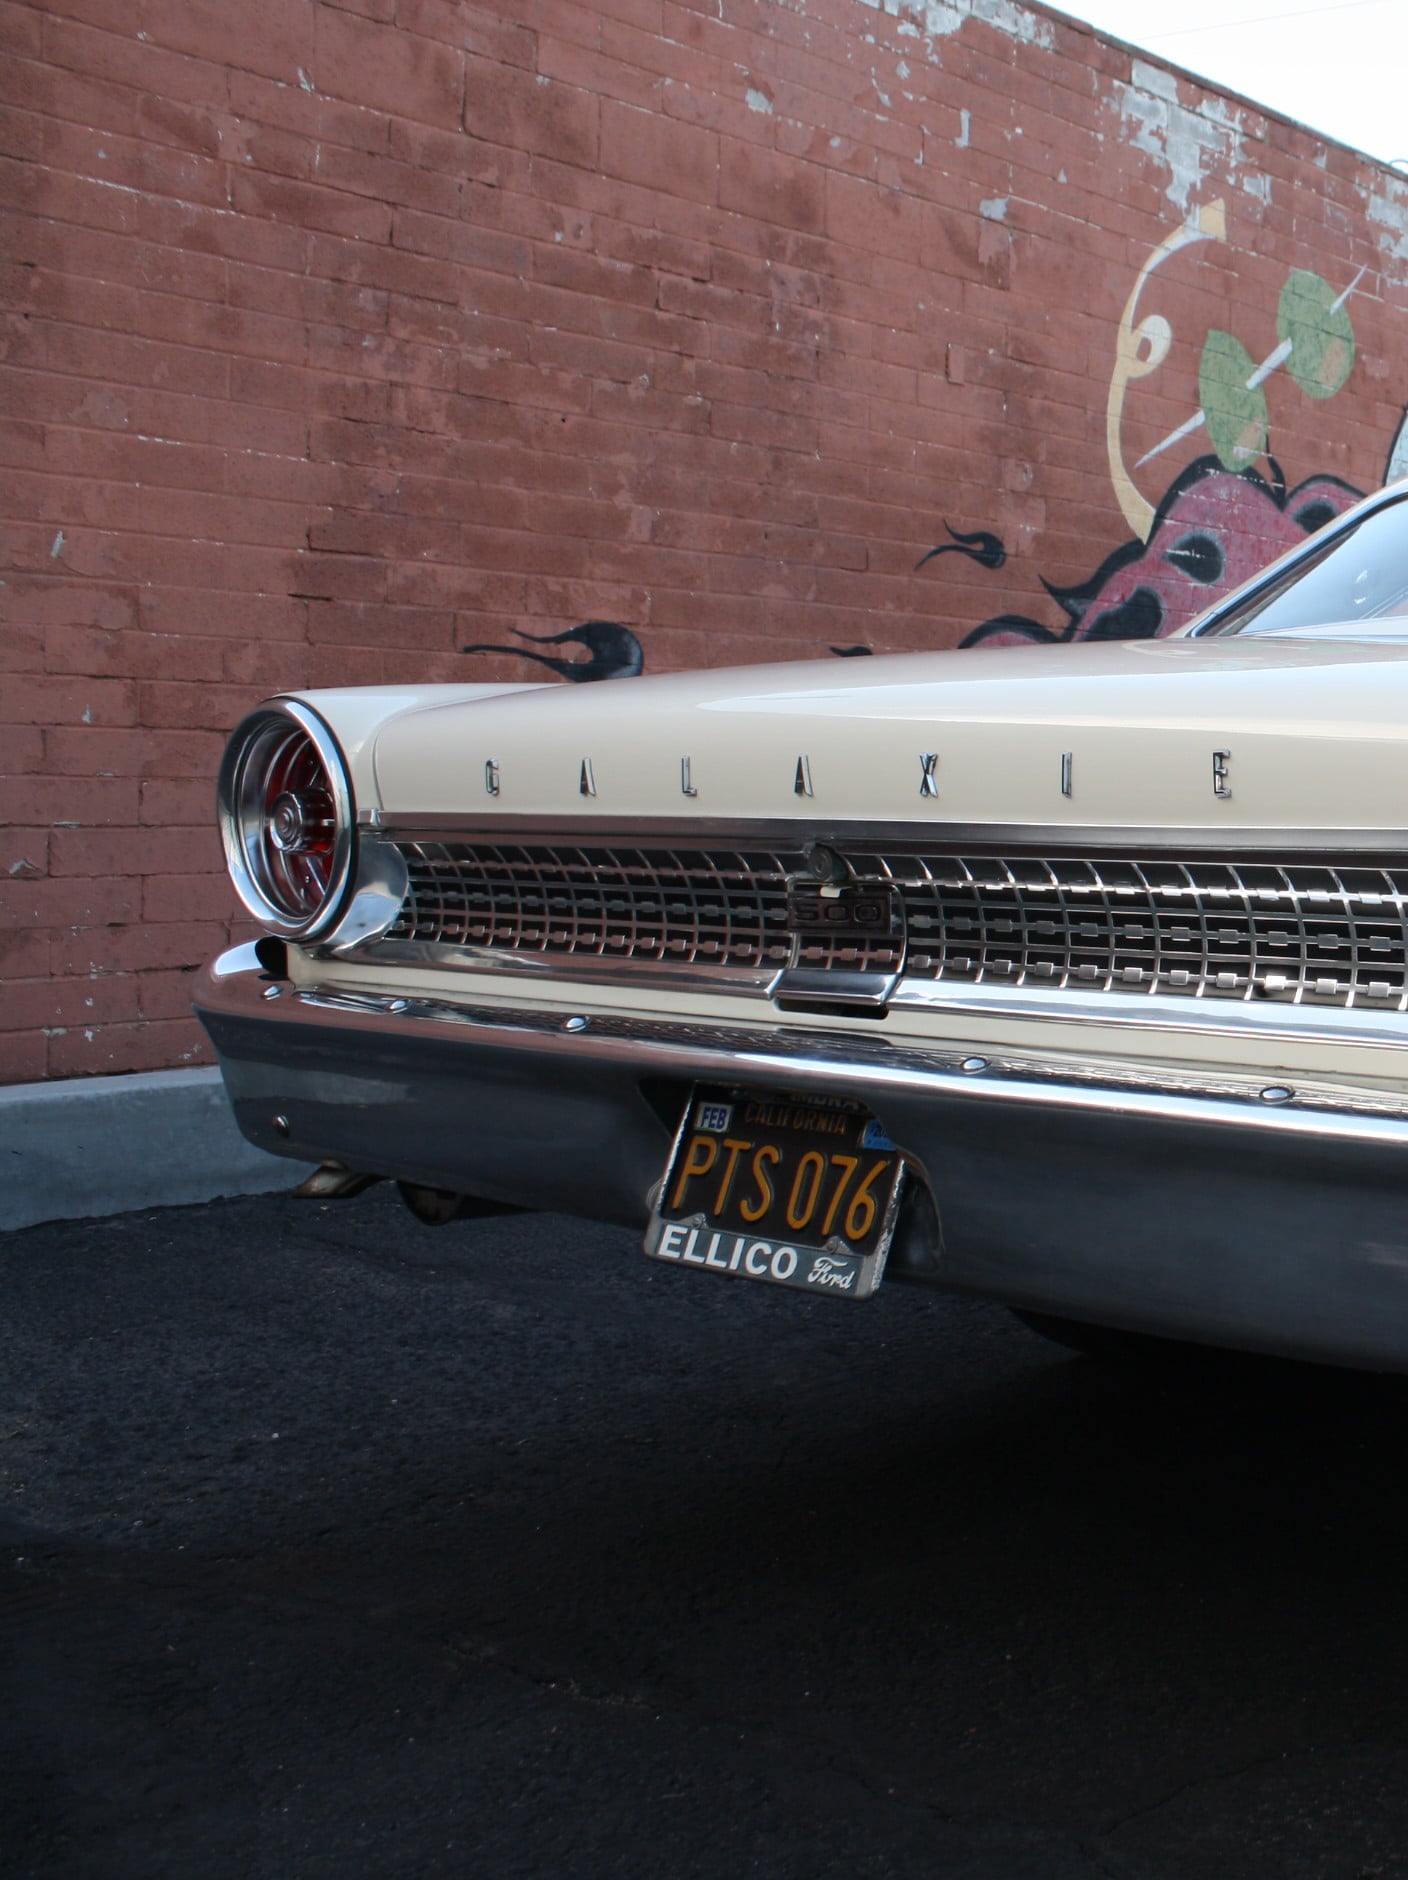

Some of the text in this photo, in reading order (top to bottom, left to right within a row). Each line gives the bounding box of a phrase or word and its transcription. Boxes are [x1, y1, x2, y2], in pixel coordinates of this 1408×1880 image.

[484, 748, 1233, 799] GALAXIE
[700, 1105, 727, 1131] FEB
[744, 1101, 848, 1135] CALIFORNIA
[671, 1135, 889, 1241] PTS 076
[657, 1224, 856, 1290] ELLICO Ford
